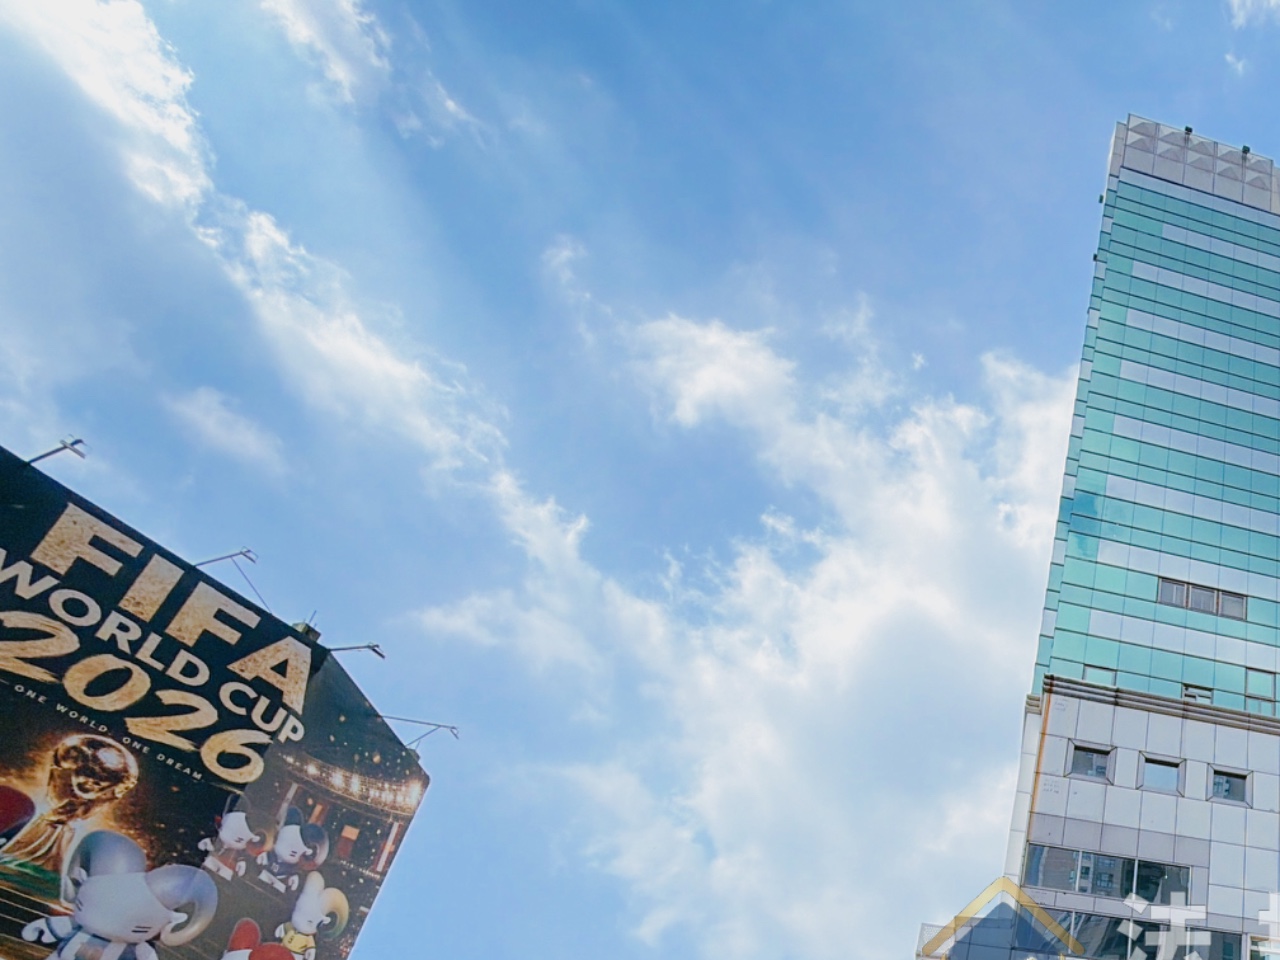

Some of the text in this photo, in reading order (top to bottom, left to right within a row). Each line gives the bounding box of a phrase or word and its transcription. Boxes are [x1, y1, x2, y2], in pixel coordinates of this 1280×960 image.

[0, 547, 305, 744] WORLD CUP
[0, 610, 273, 784] 2026
[30, 502, 312, 716] FIFA
[14, 683, 46, 704] ONE
[122, 736, 150, 754] ONE
